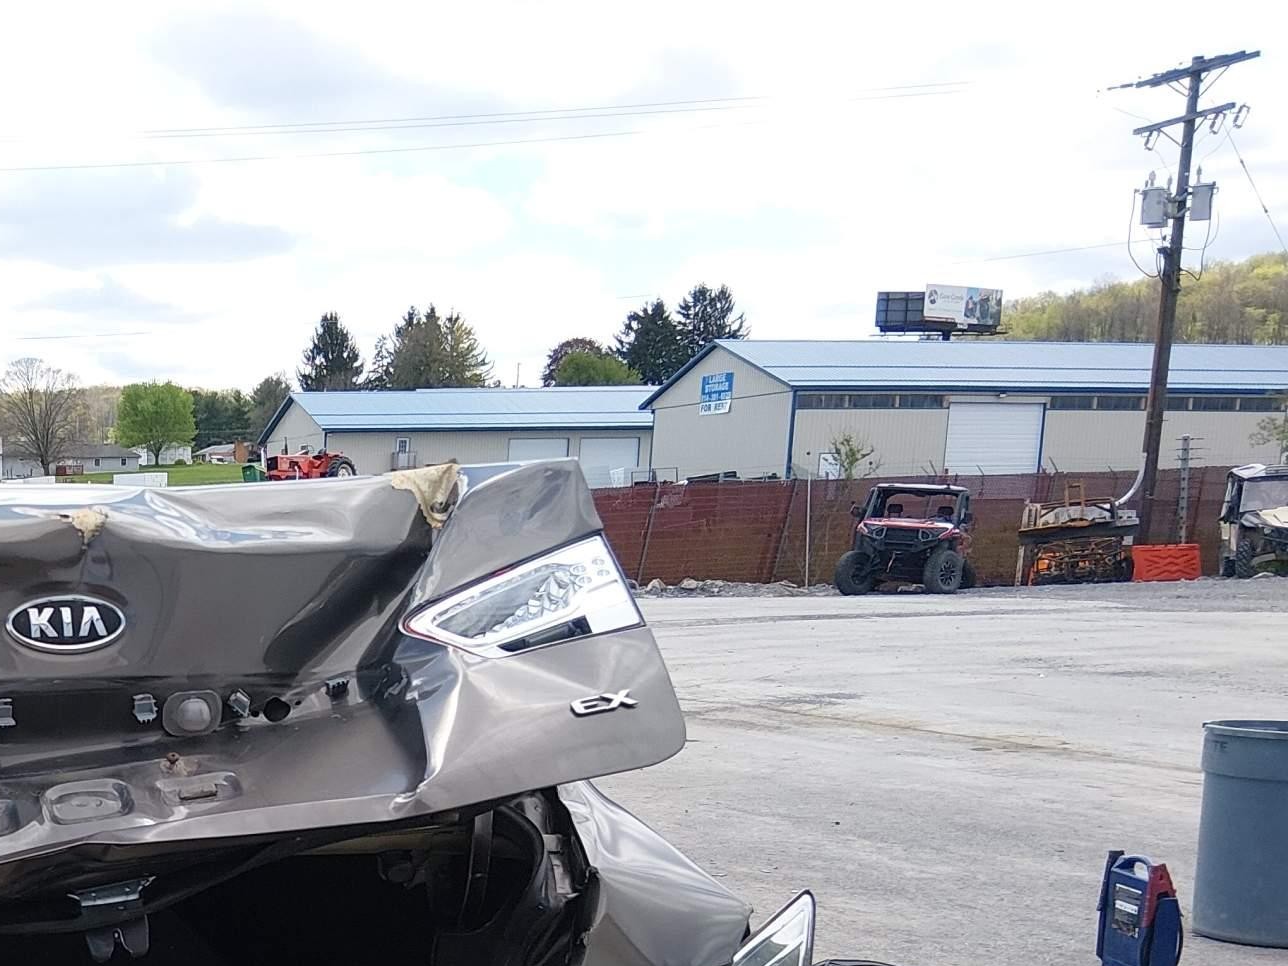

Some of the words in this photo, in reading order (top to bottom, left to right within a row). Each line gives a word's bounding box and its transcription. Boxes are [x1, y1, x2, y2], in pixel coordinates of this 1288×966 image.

[705, 382, 729, 393] STORAGE
[701, 403, 711, 412] FOR
[26, 606, 109, 639] KIA
[570, 688, 640, 716] EX
